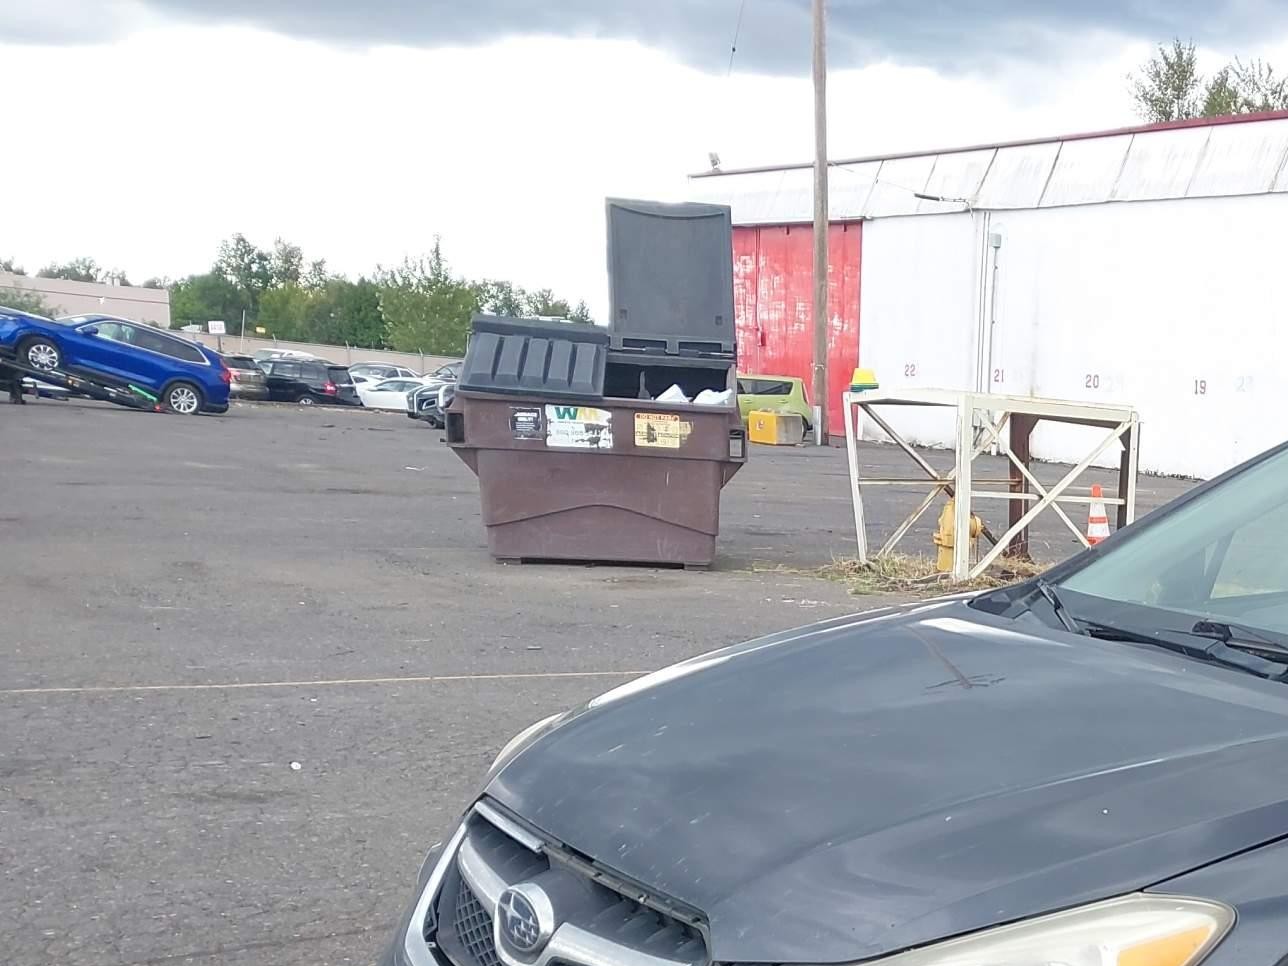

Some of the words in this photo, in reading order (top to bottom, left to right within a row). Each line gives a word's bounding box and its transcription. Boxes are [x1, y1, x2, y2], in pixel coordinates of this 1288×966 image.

[904, 363, 916, 377] 22
[993, 368, 1005, 383] 21
[1085, 374, 1100, 389] 20
[1194, 379, 1207, 395] 19
